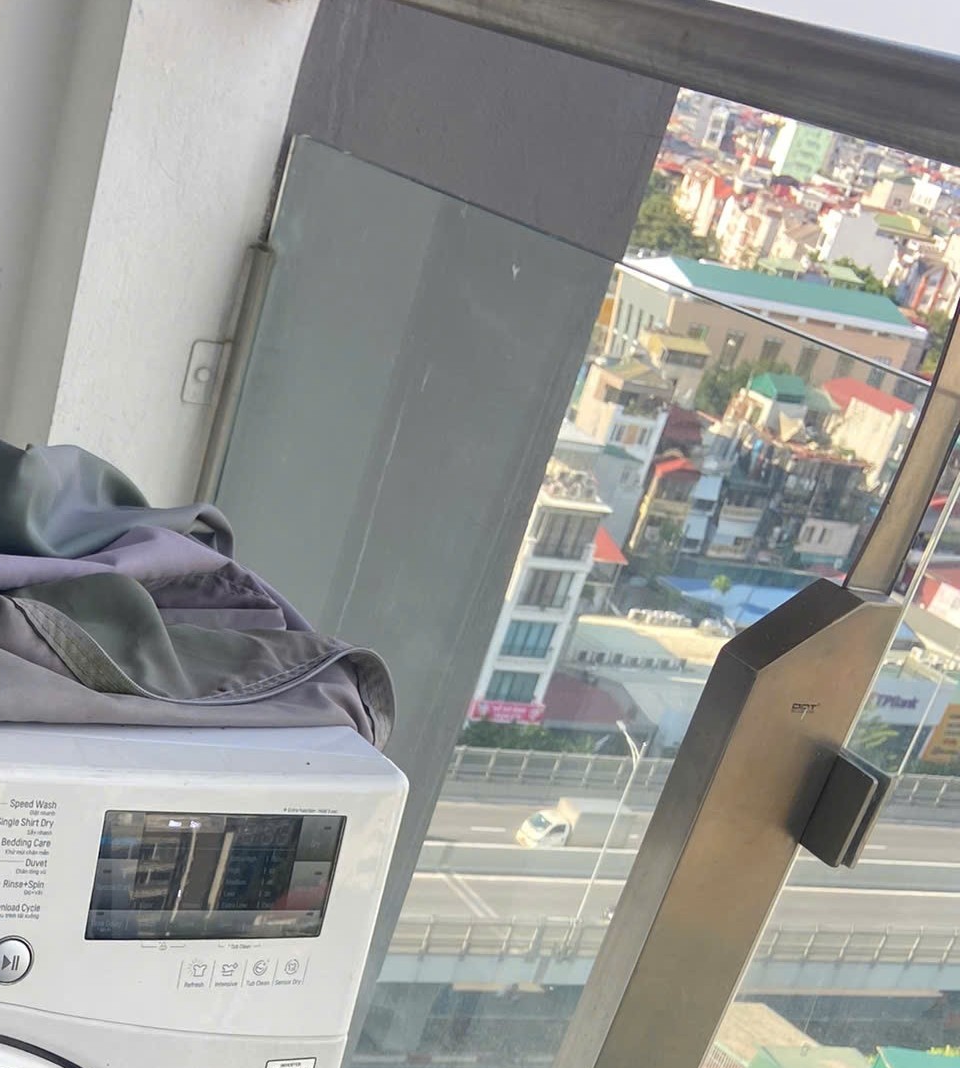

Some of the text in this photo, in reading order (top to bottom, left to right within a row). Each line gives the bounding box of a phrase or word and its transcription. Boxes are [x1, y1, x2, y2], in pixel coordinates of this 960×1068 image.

[10, 799, 57, 809] Speed Wash
[20, 818, 40, 827] Shirt
[40, 818, 55, 829] Dry
[1, 837, 51, 849] Bedding Care
[25, 858, 48, 868] Duvet
[2, 879, 45, 890] Rinse+Spin
[21, 903, 41, 913] Cycle
